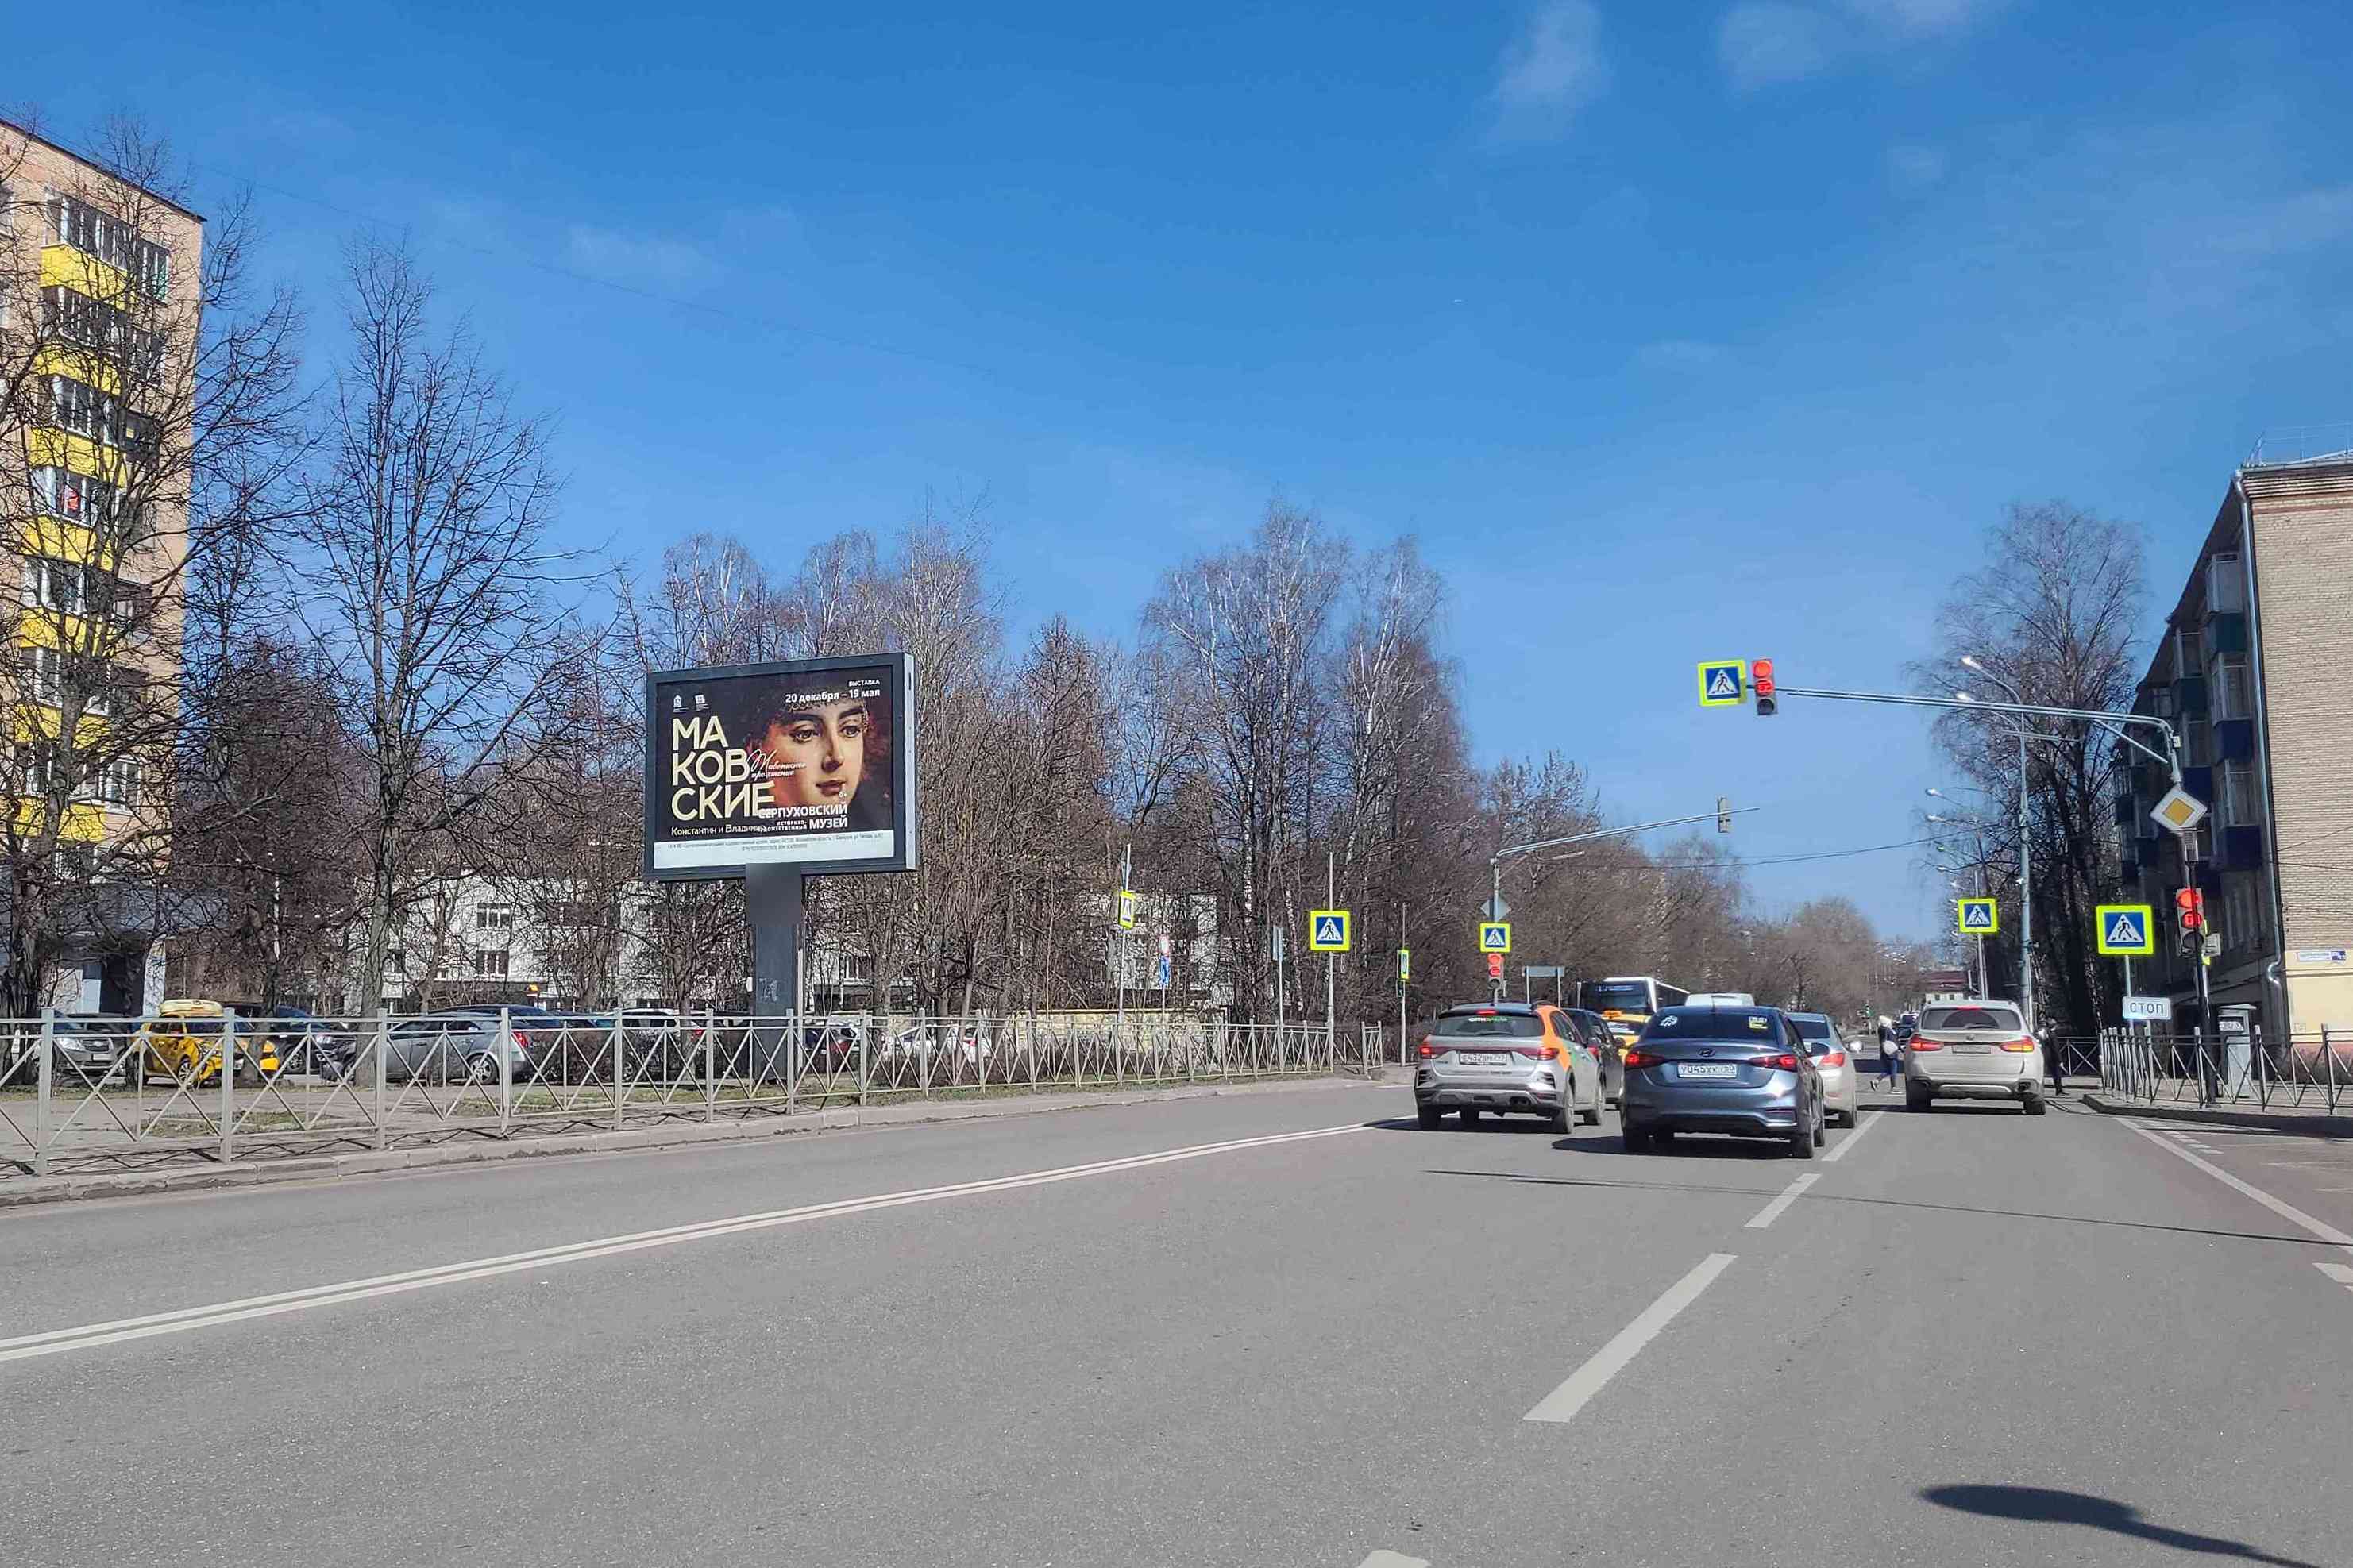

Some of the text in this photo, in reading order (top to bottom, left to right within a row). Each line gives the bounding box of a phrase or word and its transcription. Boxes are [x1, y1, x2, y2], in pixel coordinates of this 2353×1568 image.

[785, 694, 797, 703] 20
[799, 691, 839, 704] декабря
[849, 688, 859, 699] 19
[862, 689, 880, 698] мая
[673, 715, 728, 751] МА
[673, 749, 750, 786] КОВ
[672, 780, 775, 821] СКИЕ
[758, 801, 848, 819] СЕРПУХОВСКИЙ
[809, 815, 848, 830] МУЗЕЙ
[671, 826, 716, 837] Константин
[2130, 1001, 2164, 1014] СТОП
